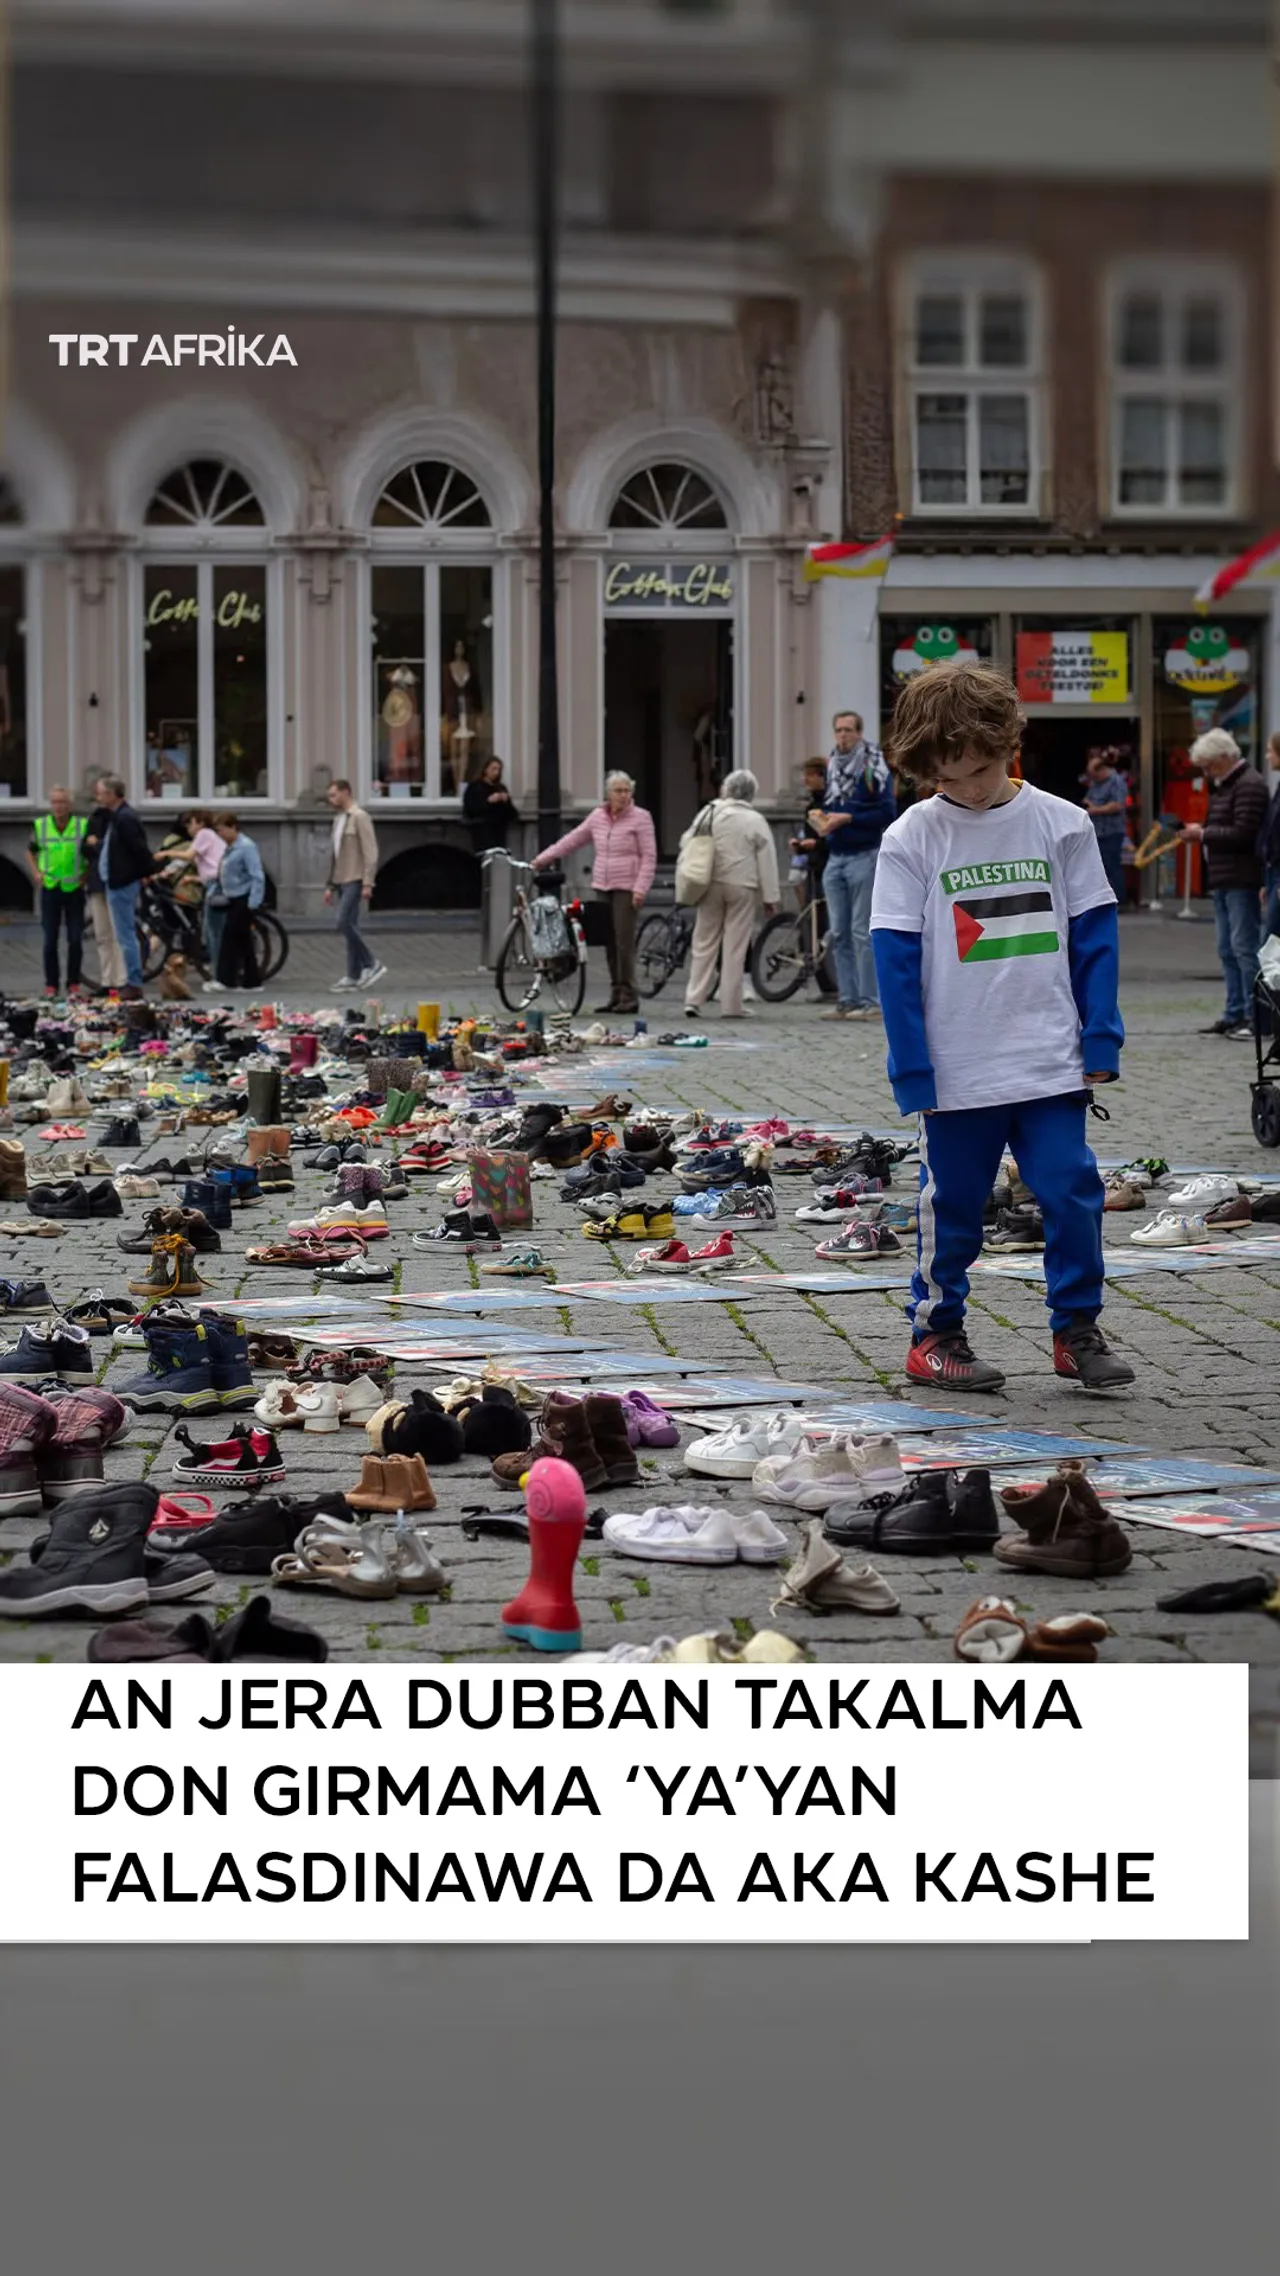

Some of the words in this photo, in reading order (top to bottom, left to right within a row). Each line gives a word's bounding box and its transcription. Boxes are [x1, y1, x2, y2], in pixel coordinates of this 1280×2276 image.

[684, 563, 732, 605] Club
[1050, 645, 1094, 655] ALLES
[1037, 657, 1077, 667] VOOR
[948, 861, 1047, 890] PALESTINA
